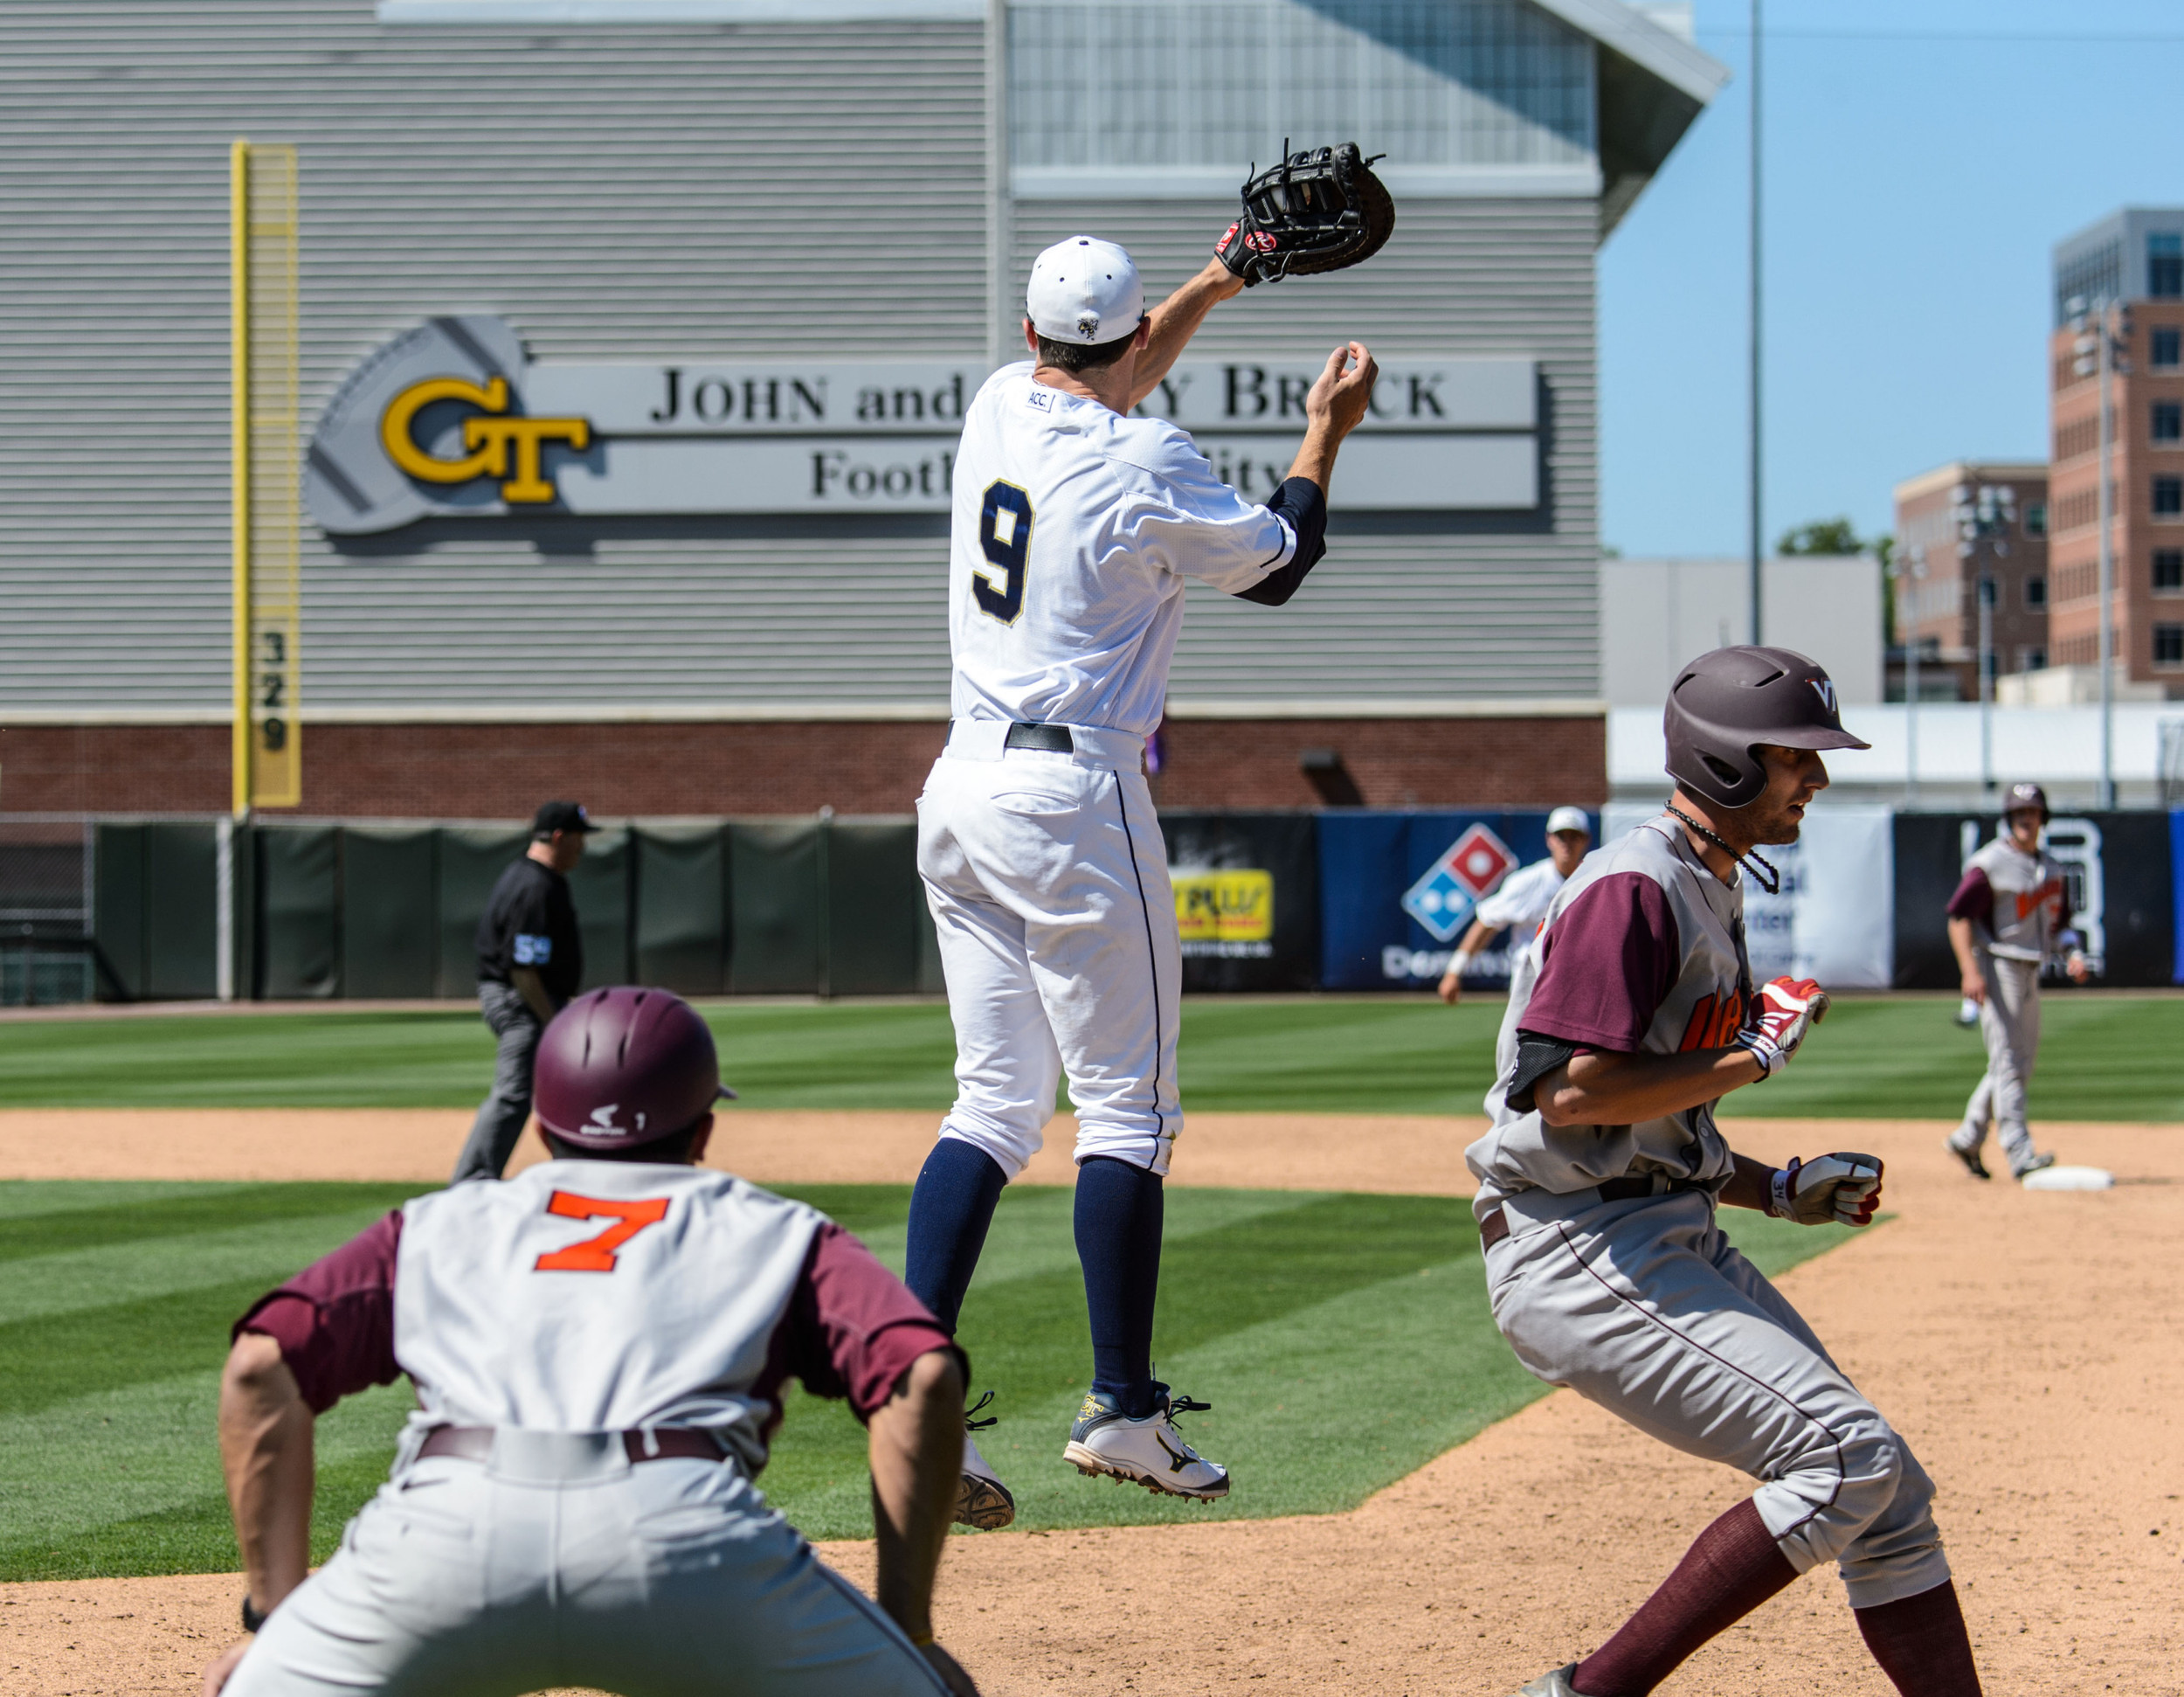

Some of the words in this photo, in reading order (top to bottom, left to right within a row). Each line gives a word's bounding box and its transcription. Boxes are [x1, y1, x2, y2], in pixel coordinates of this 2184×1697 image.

[650, 367, 829, 424] JOHN
[856, 373, 964, 421] and
[1221, 364, 1446, 419] BRCK
[381, 377, 590, 503] GT
[971, 477, 1036, 627] 9
[263, 632, 286, 752] 329
[635, 1112, 646, 1132] 1
[534, 1190, 672, 1272] 7
